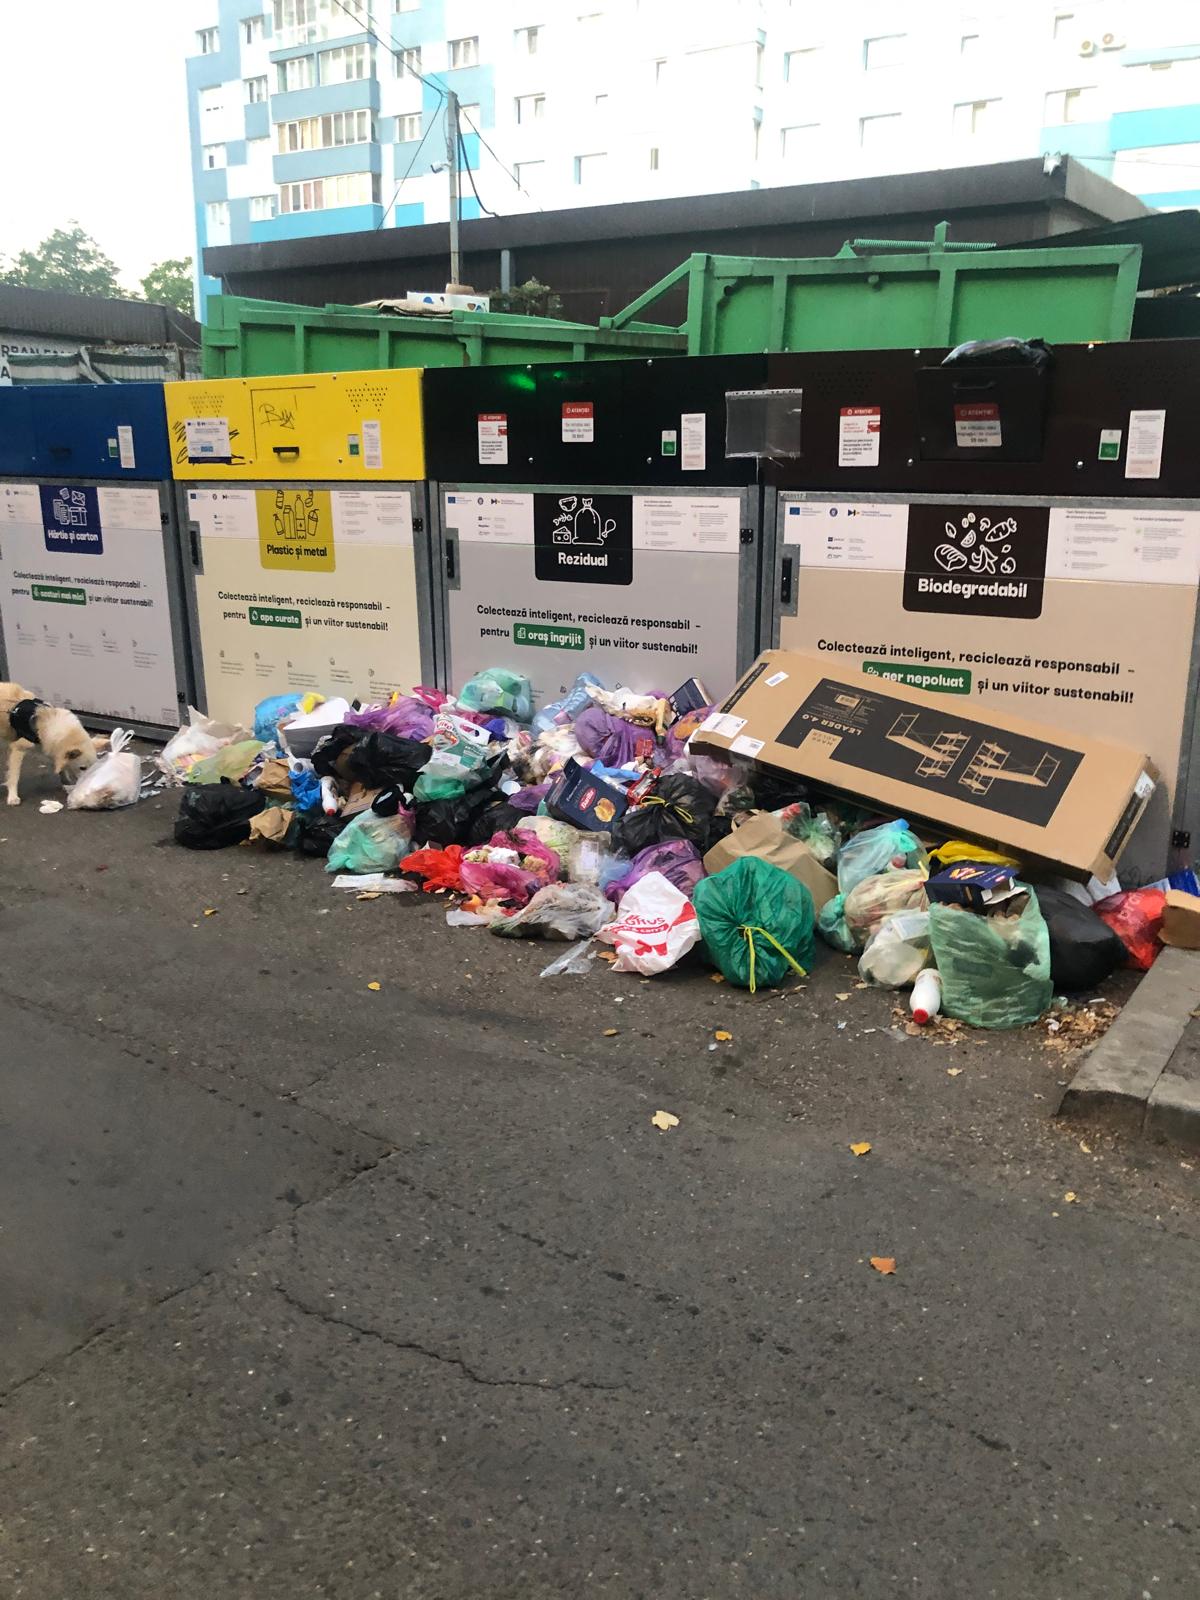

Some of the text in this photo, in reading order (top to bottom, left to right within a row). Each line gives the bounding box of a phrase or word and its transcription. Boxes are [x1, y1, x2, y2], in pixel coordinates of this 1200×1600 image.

[76, 532, 99, 541] carton
[266, 543, 327, 560] Plastic și metal
[558, 551, 608, 567] Rezidual
[918, 578, 1028, 599] Biodegradabil
[218, 591, 258, 602] Colectează
[258, 594, 295, 606] inteligent,
[296, 595, 336, 608] reciclează
[336, 600, 383, 611] responsabil
[223, 611, 246, 620] pentru
[260, 614, 300, 624] ape curate
[477, 604, 527, 618] Colectează
[529, 608, 576, 624] inteligent,
[577, 612, 629, 626] reciclează
[630, 617, 690, 630] responsabil
[305, 618, 311, 628] și
[324, 618, 343, 627] viitor
[345, 621, 388, 631] sustenabil!
[480, 627, 510, 638] pentru
[528, 631, 582, 647] oraș îngrijit
[589, 636, 698, 654] și un viitor sustenabil!
[817, 639, 887, 656] Colectează
[890, 643, 956, 663] inteligent,
[959, 651, 1032, 668] reciclează
[1034, 657, 1120, 675] responsabil
[882, 671, 965, 688] aer nepoluat
[977, 678, 1135, 704] și un viitor sustenabil!
[802, 713, 862, 736] LEADER 4.0
